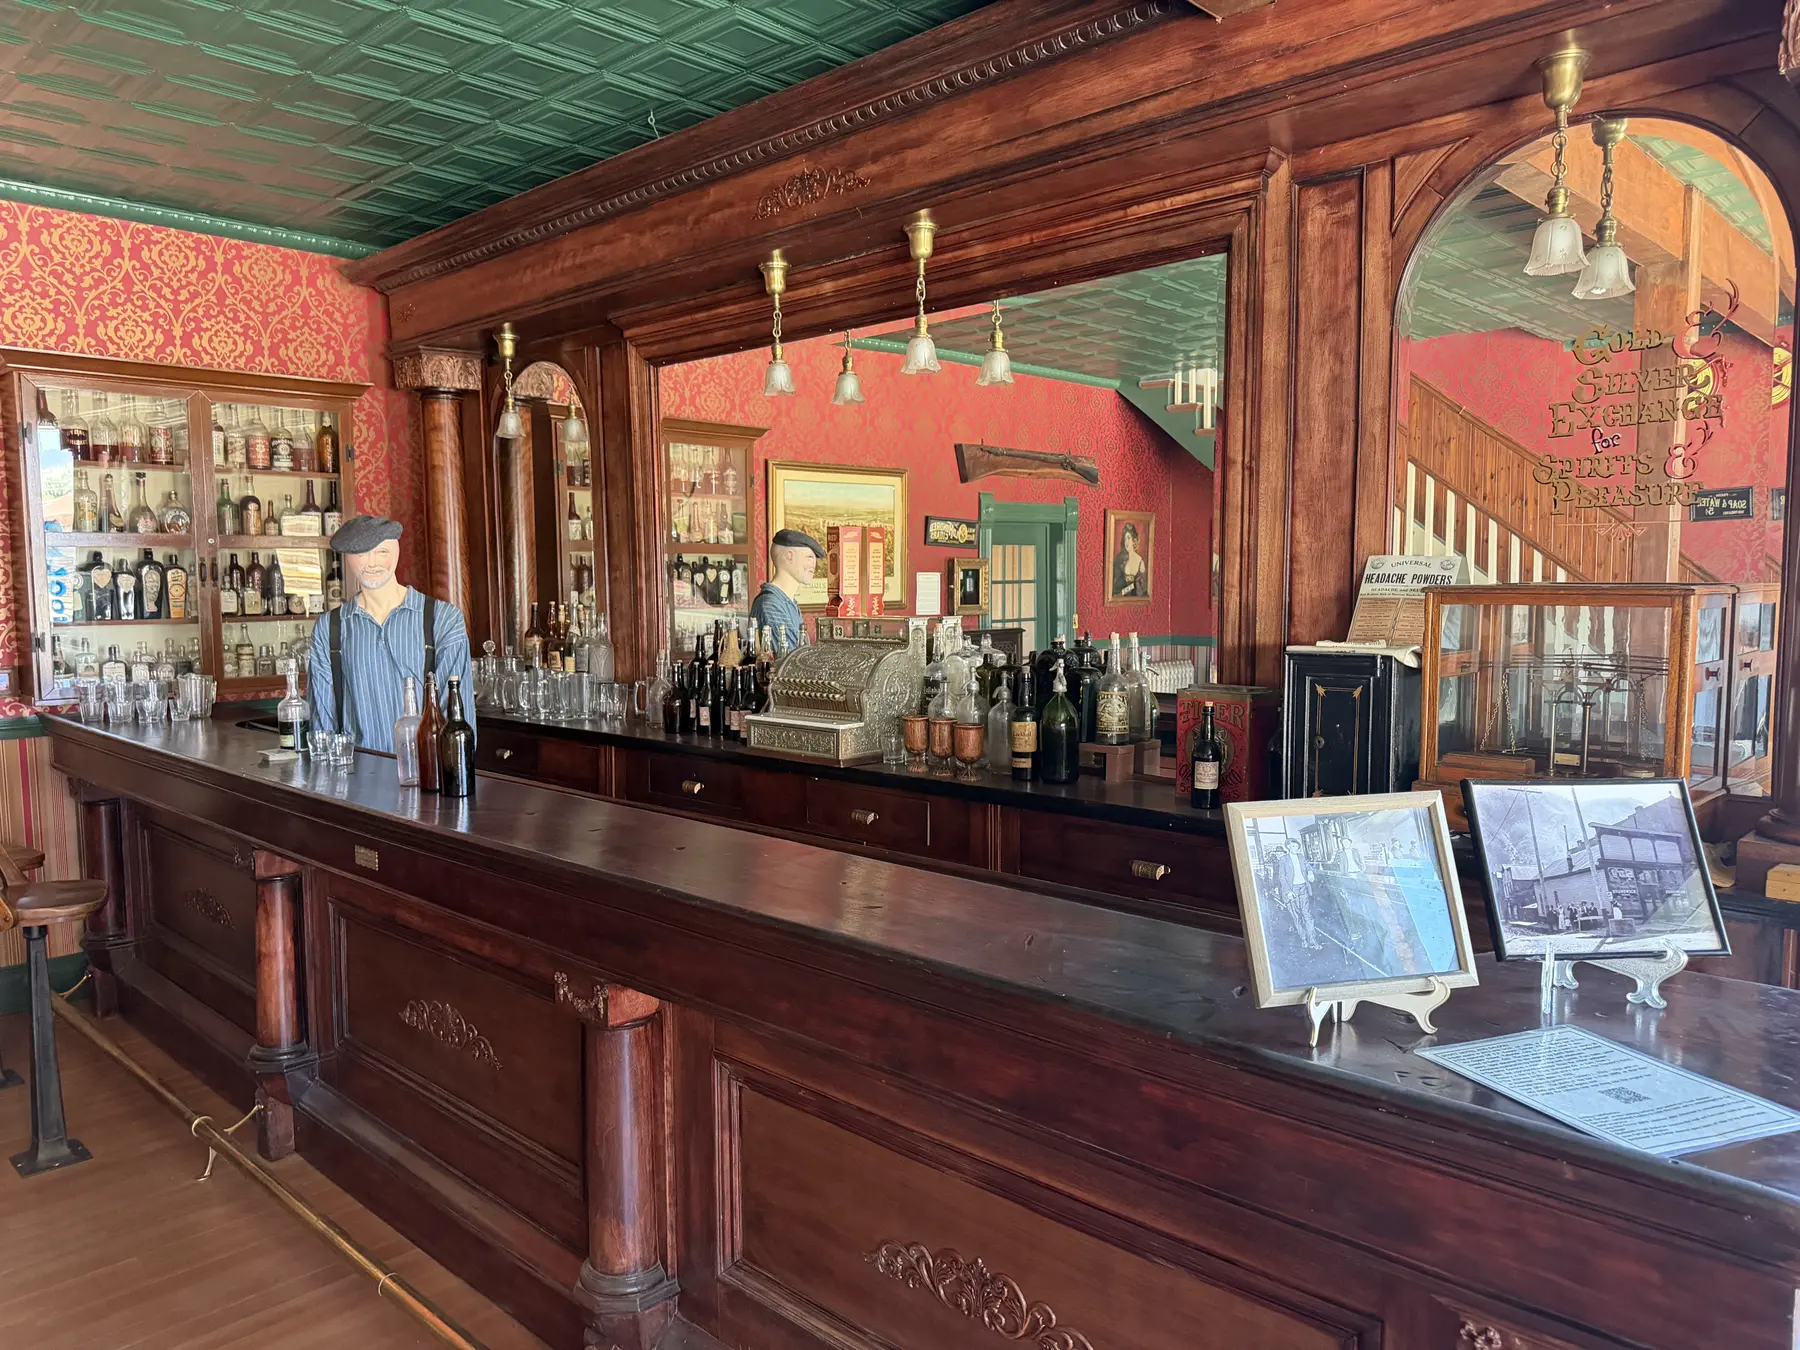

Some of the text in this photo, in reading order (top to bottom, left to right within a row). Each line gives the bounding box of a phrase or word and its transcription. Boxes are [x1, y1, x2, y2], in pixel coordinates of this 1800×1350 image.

[1572, 325, 1663, 365] GOLD
[1572, 364, 1710, 404] SILVER
[1548, 394, 1724, 438] EXCHANGE
[1591, 427, 1621, 454] for
[1533, 453, 1654, 485] SPIRITS
[1550, 481, 1705, 515] PLEASURE
[1364, 573, 1453, 585] HEADACHE POWDERS
[1390, 560, 1432, 568] UNIVERSAL
[1180, 700, 1245, 730] TIER
